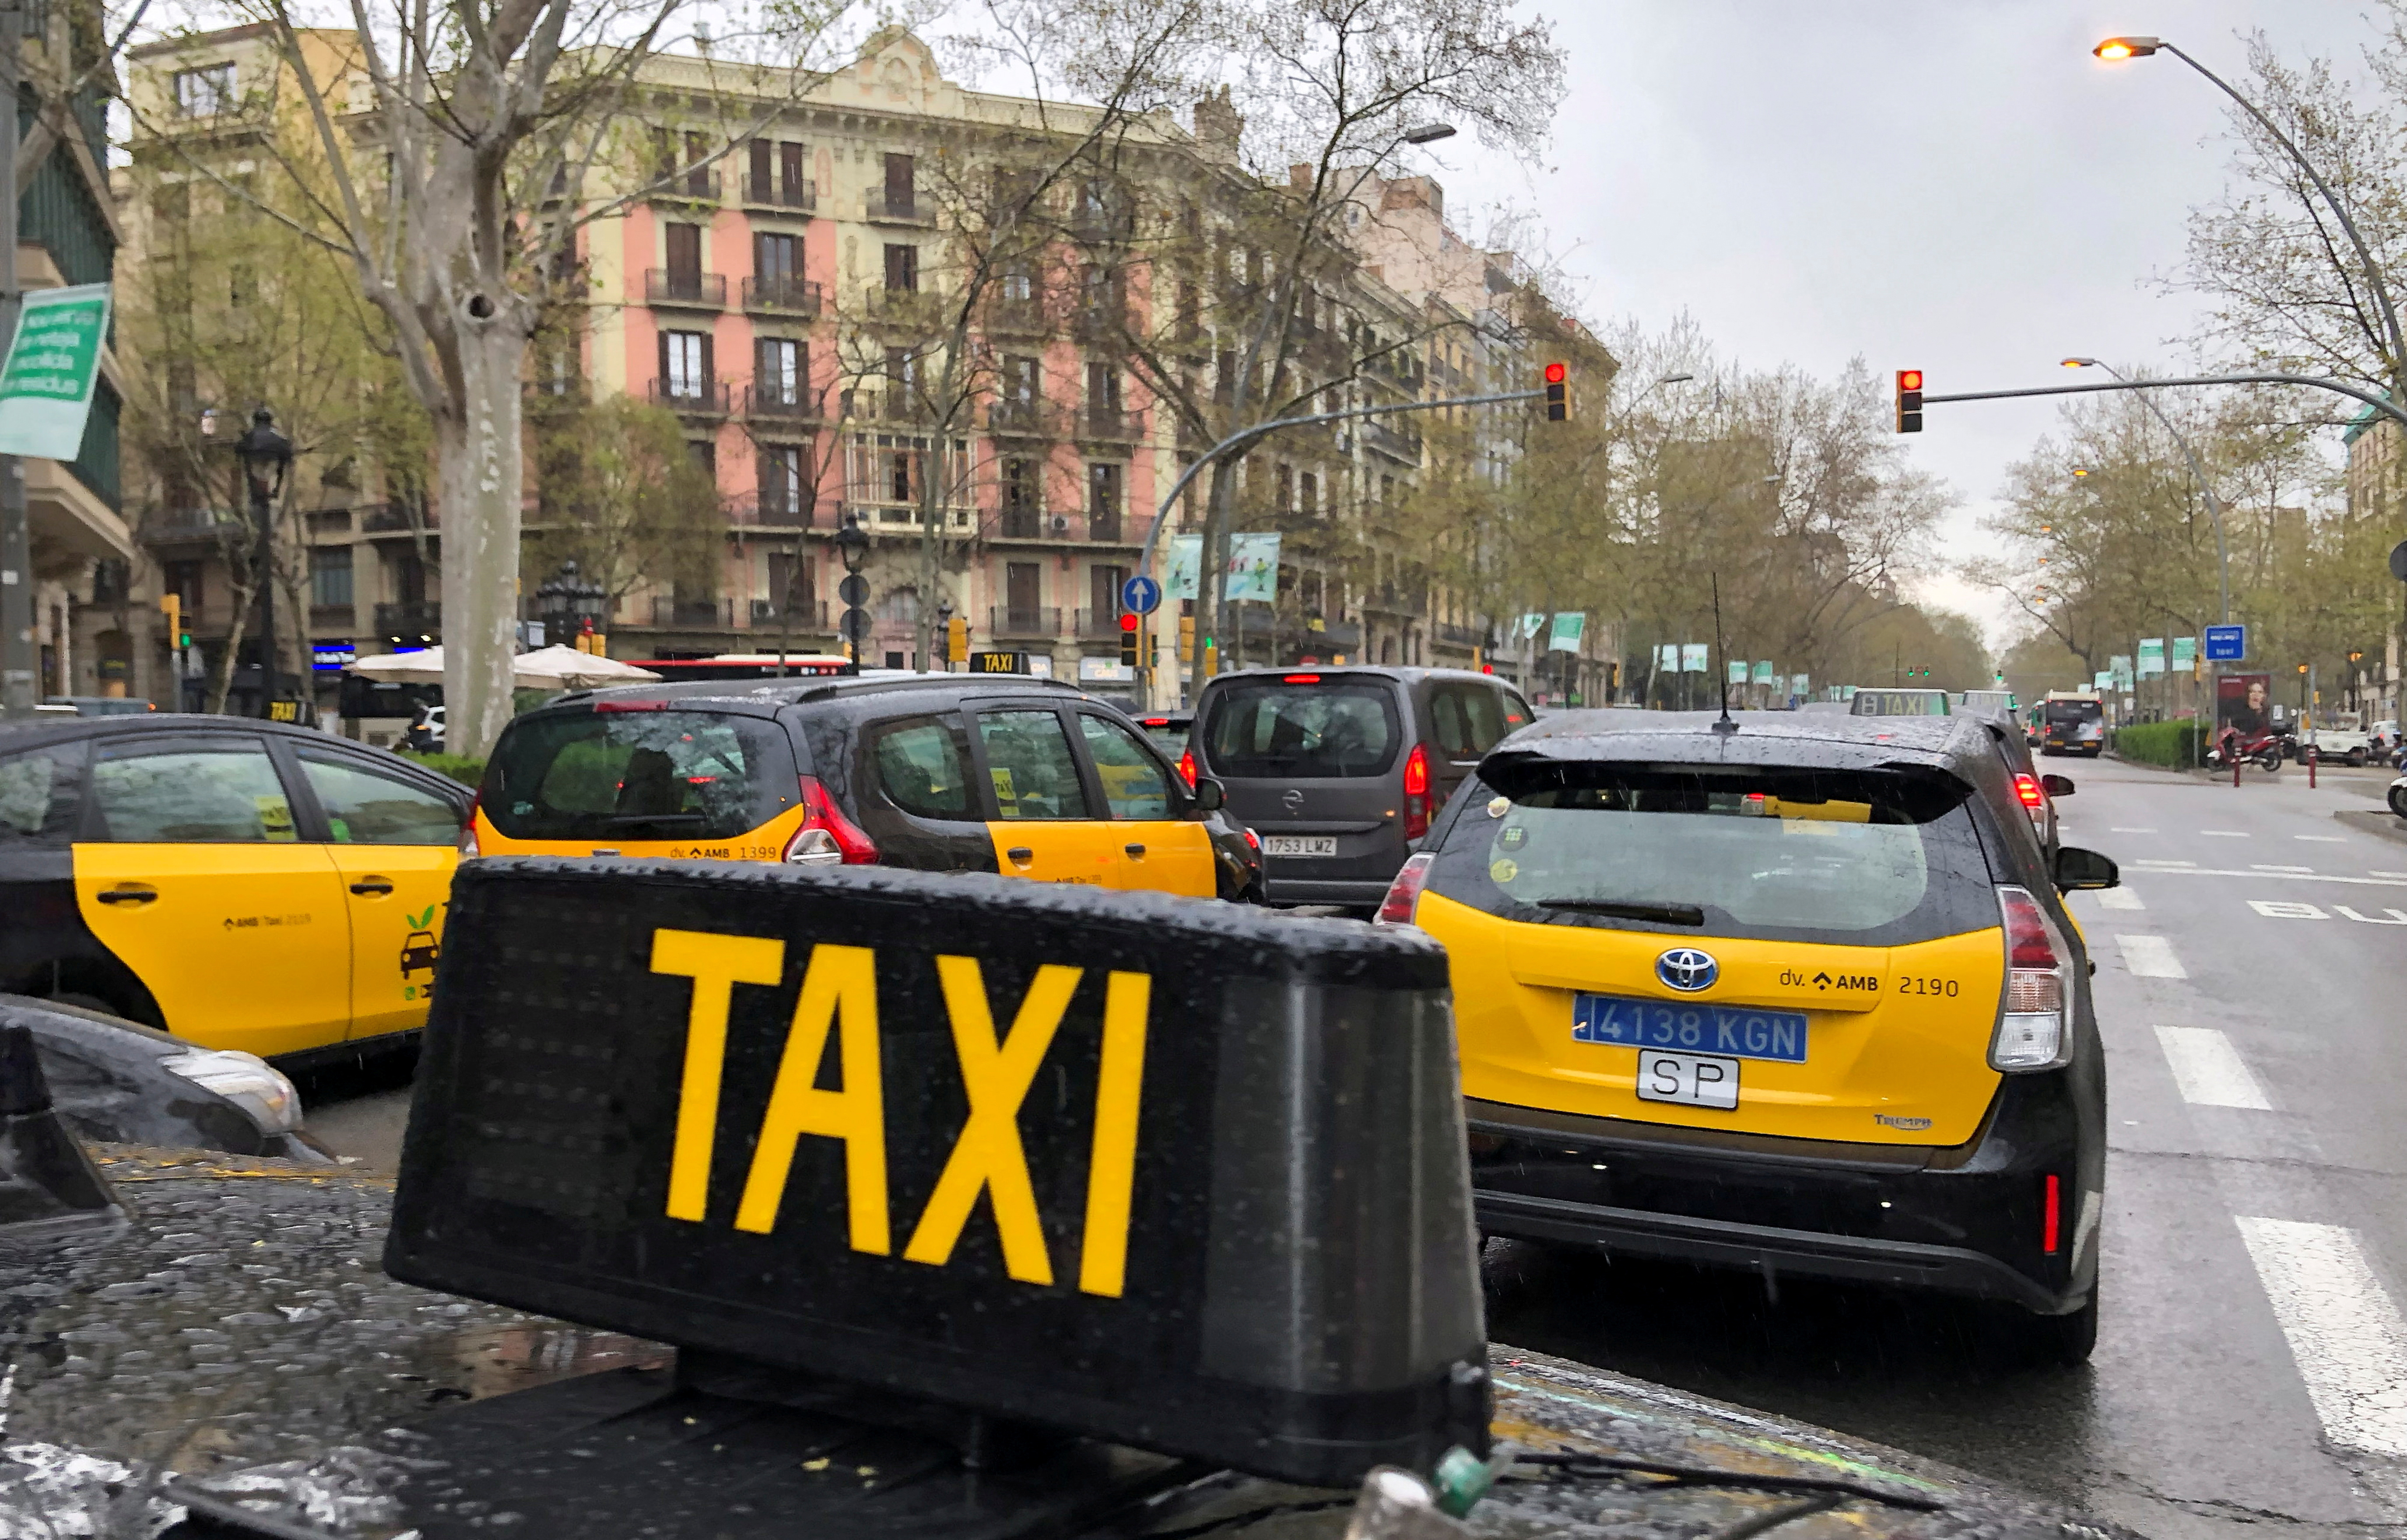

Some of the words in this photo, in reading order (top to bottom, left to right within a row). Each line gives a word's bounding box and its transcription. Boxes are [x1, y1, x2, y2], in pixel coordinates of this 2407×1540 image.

[984, 654, 1013, 672] TAXI
[1883, 694, 1925, 716] TAXI
[704, 849, 730, 858] AMB
[740, 847, 776, 858] 1399
[1269, 839, 1300, 852] 1753
[1780, 969, 1805, 987] dv.
[1836, 975, 1877, 991] AMB
[1899, 976, 1958, 997] 2190
[1600, 1003, 1701, 1046] 4138
[1717, 1013, 1796, 1055] KGN
[650, 928, 1152, 1298] TAXI
